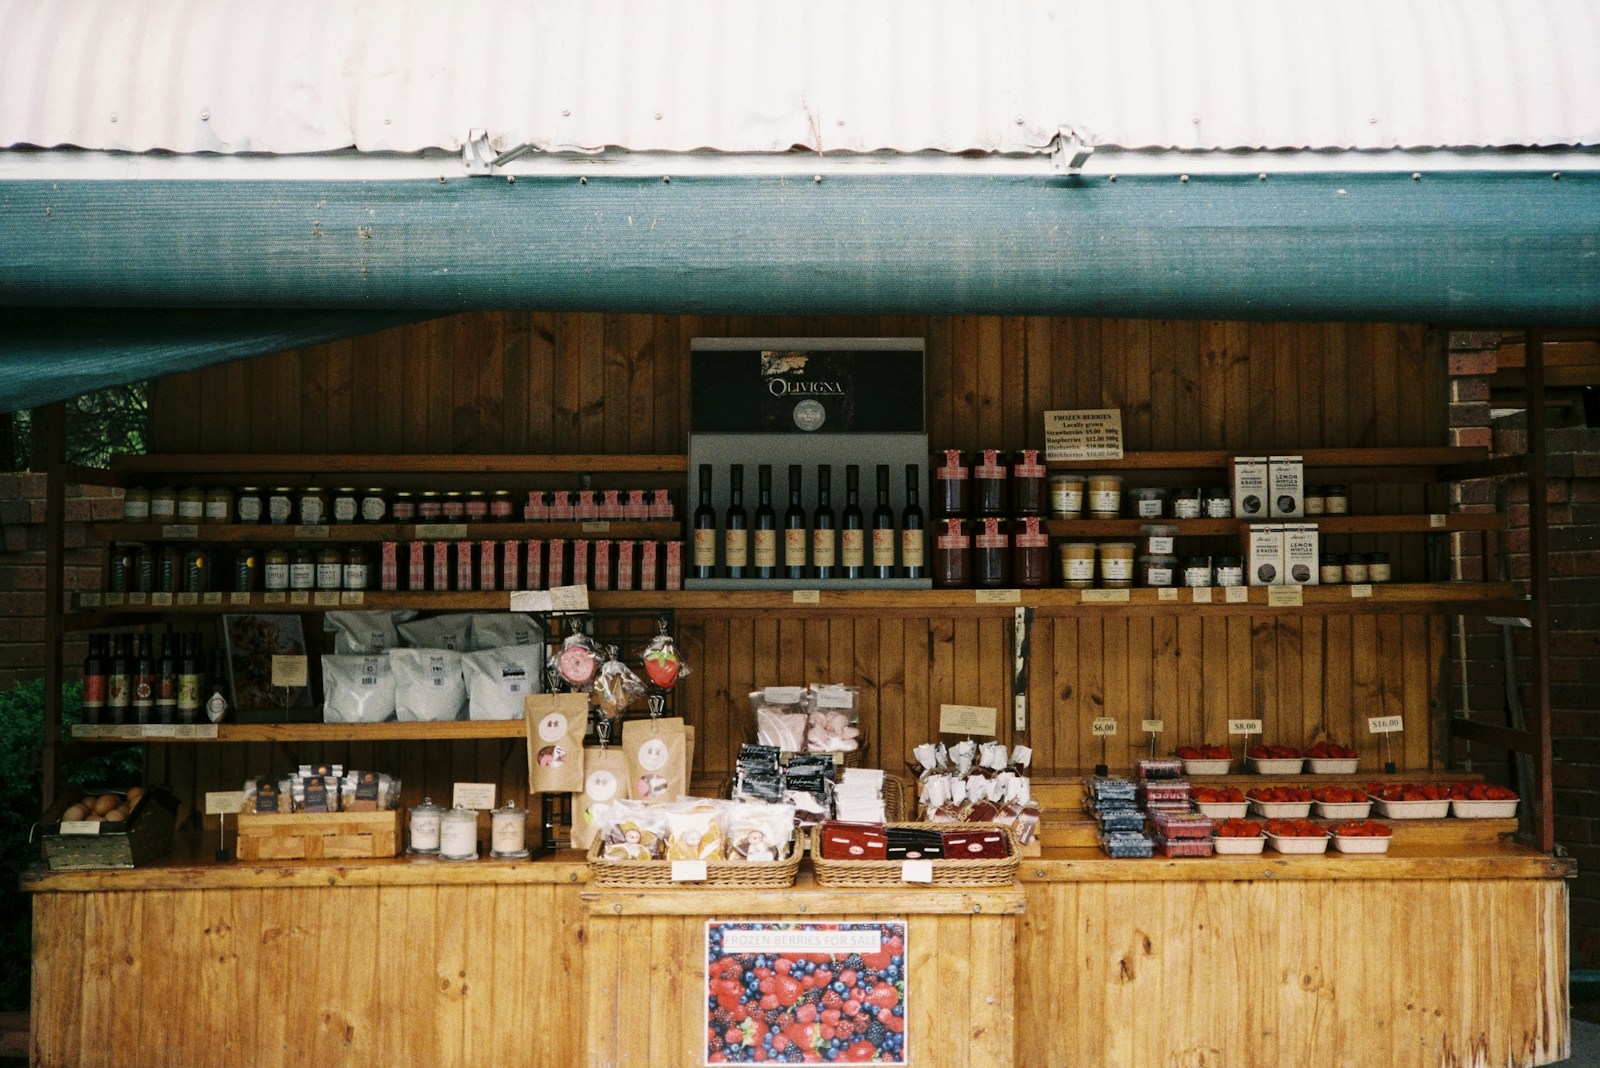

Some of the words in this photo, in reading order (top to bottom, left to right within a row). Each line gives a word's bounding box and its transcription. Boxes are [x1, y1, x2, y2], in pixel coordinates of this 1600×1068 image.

[768, 378, 843, 397] OLIVIGNA
[1094, 724, 1114, 732] $6.00
[1234, 722, 1256, 731] $8.00
[1372, 718, 1399, 729] $16.00
[1016, 813, 1030, 835] UDGE
[724, 935, 771, 946] FROZEN
[774, 935, 822, 946] BERRIES
[824, 935, 848, 946] FOR
[851, 935, 878, 946] SALE
